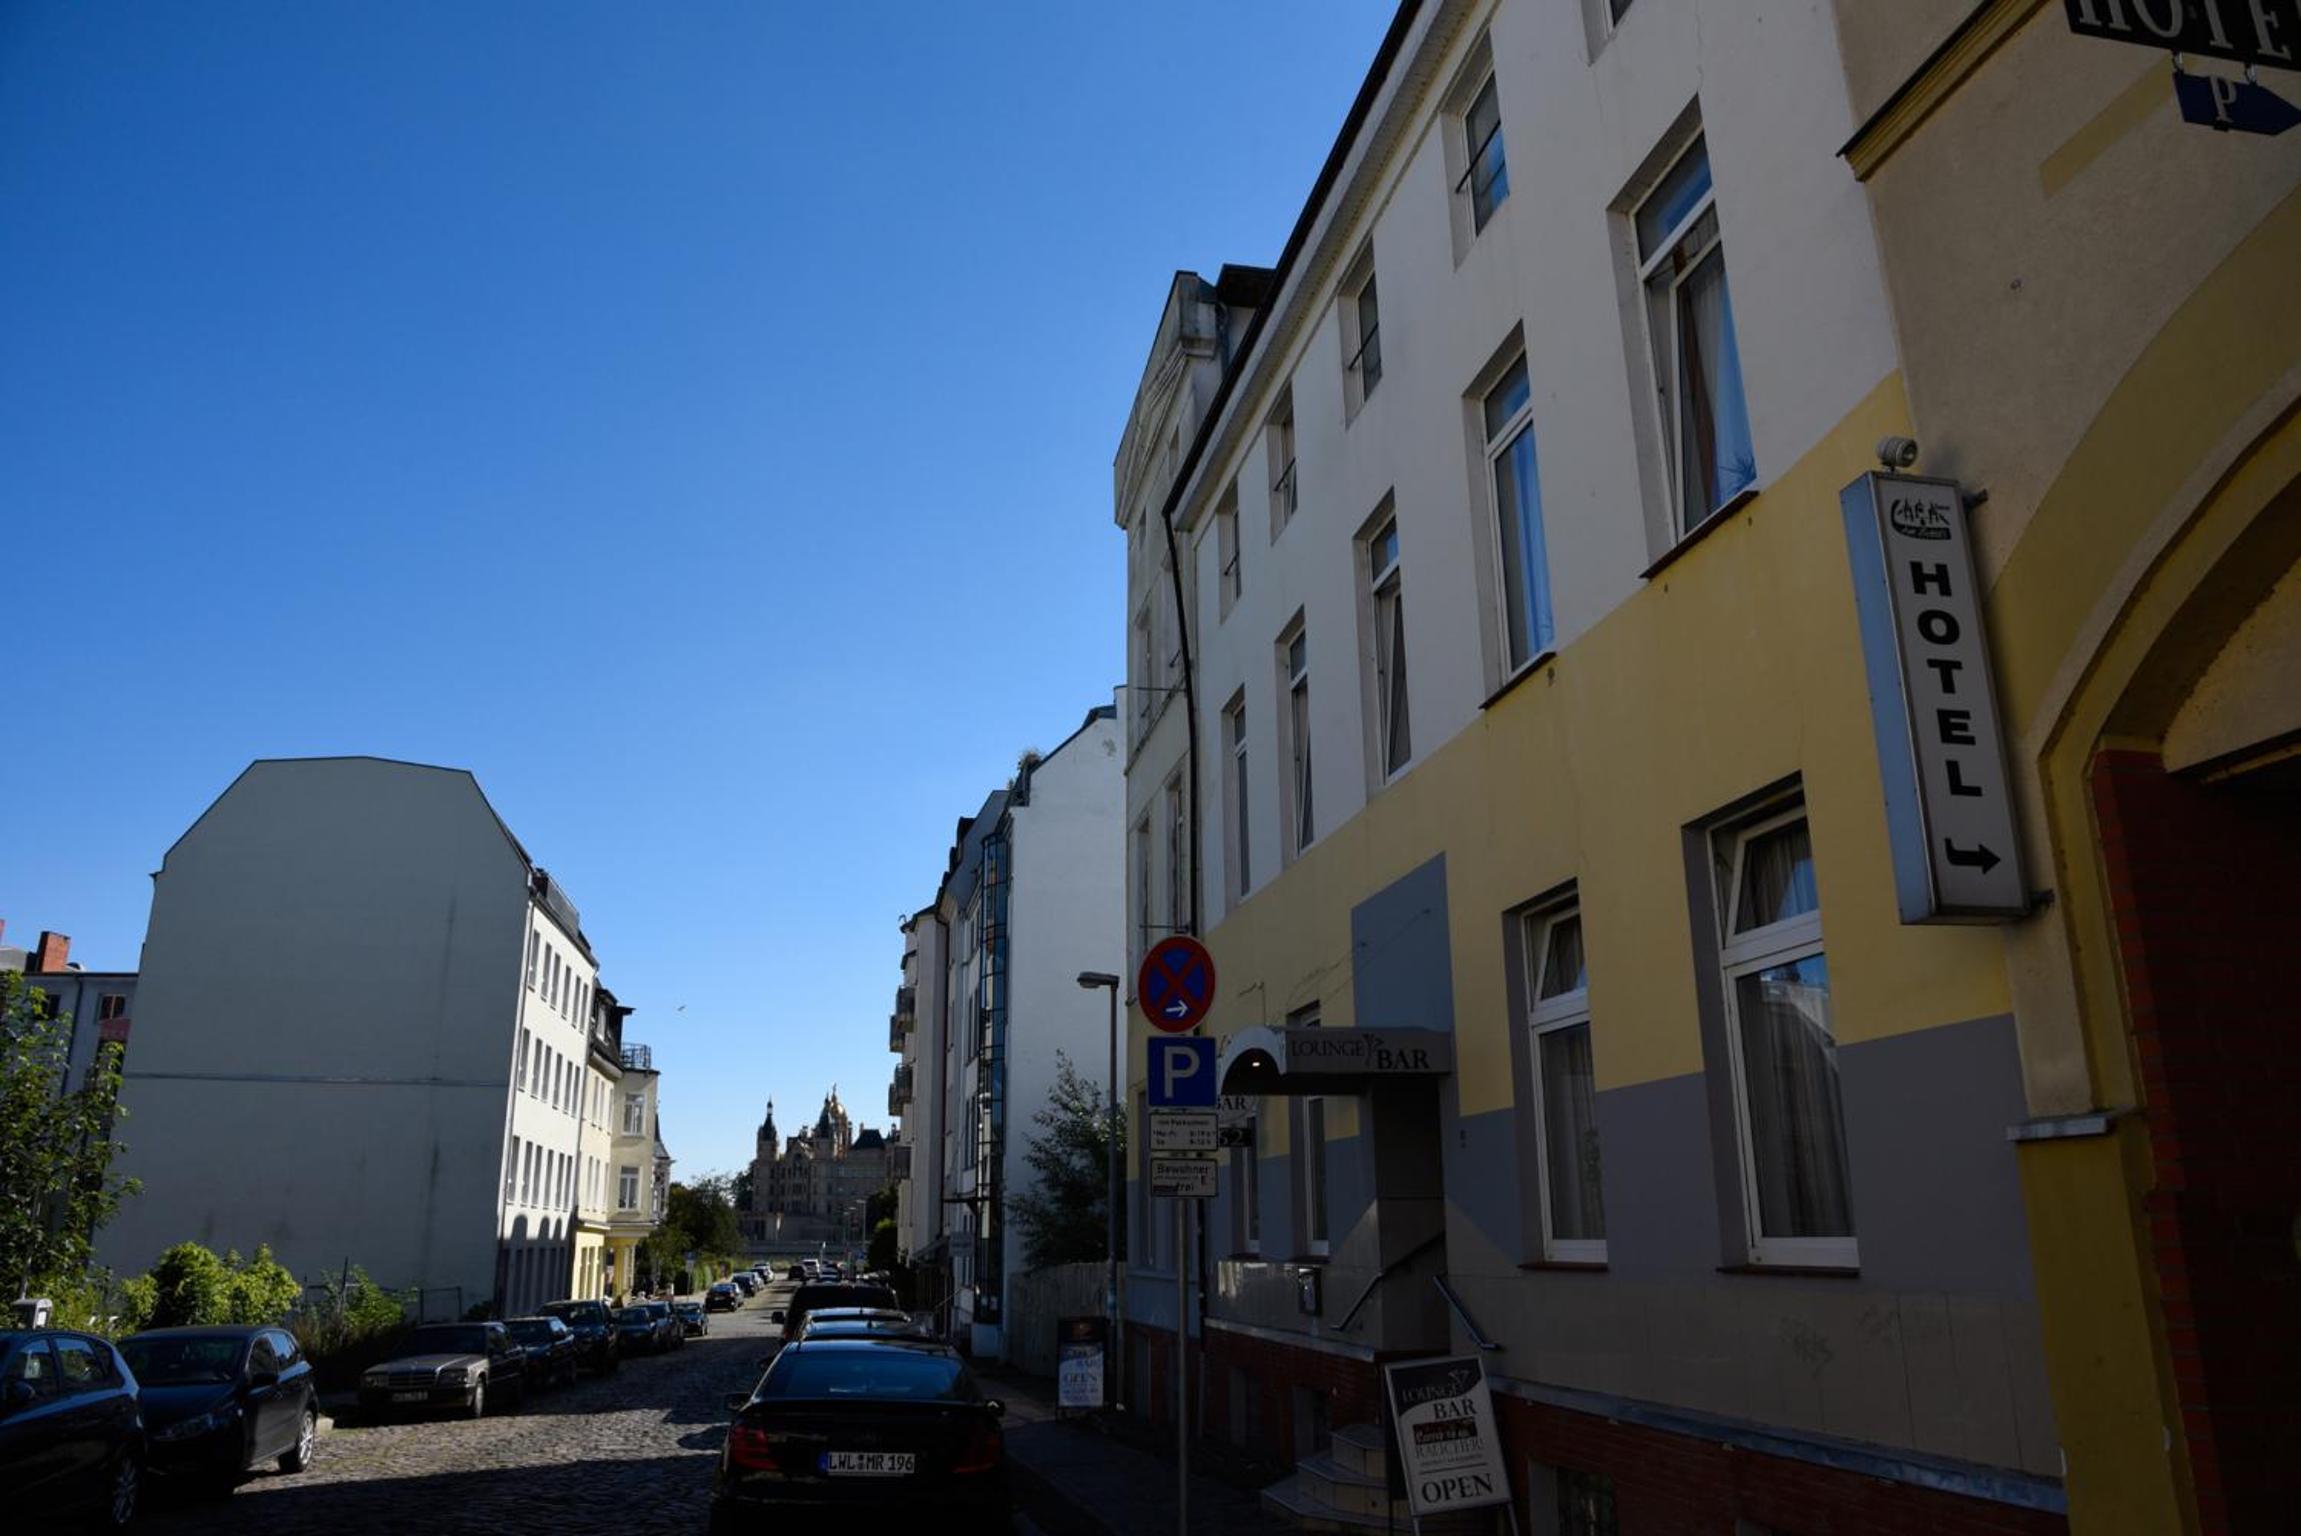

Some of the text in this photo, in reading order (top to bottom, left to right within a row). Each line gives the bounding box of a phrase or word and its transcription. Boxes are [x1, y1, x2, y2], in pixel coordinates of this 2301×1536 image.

[2208, 76, 2238, 123] P
[1909, 561, 1982, 797] HOTEL
[1292, 1039, 1430, 1070] LOUNGE BAR
[1163, 1045, 1200, 1099] P
[1433, 1399, 1477, 1420] BAR
[829, 1454, 855, 1470] LWL
[888, 1454, 914, 1470] 196
[1422, 1473, 1493, 1504] OPEN
